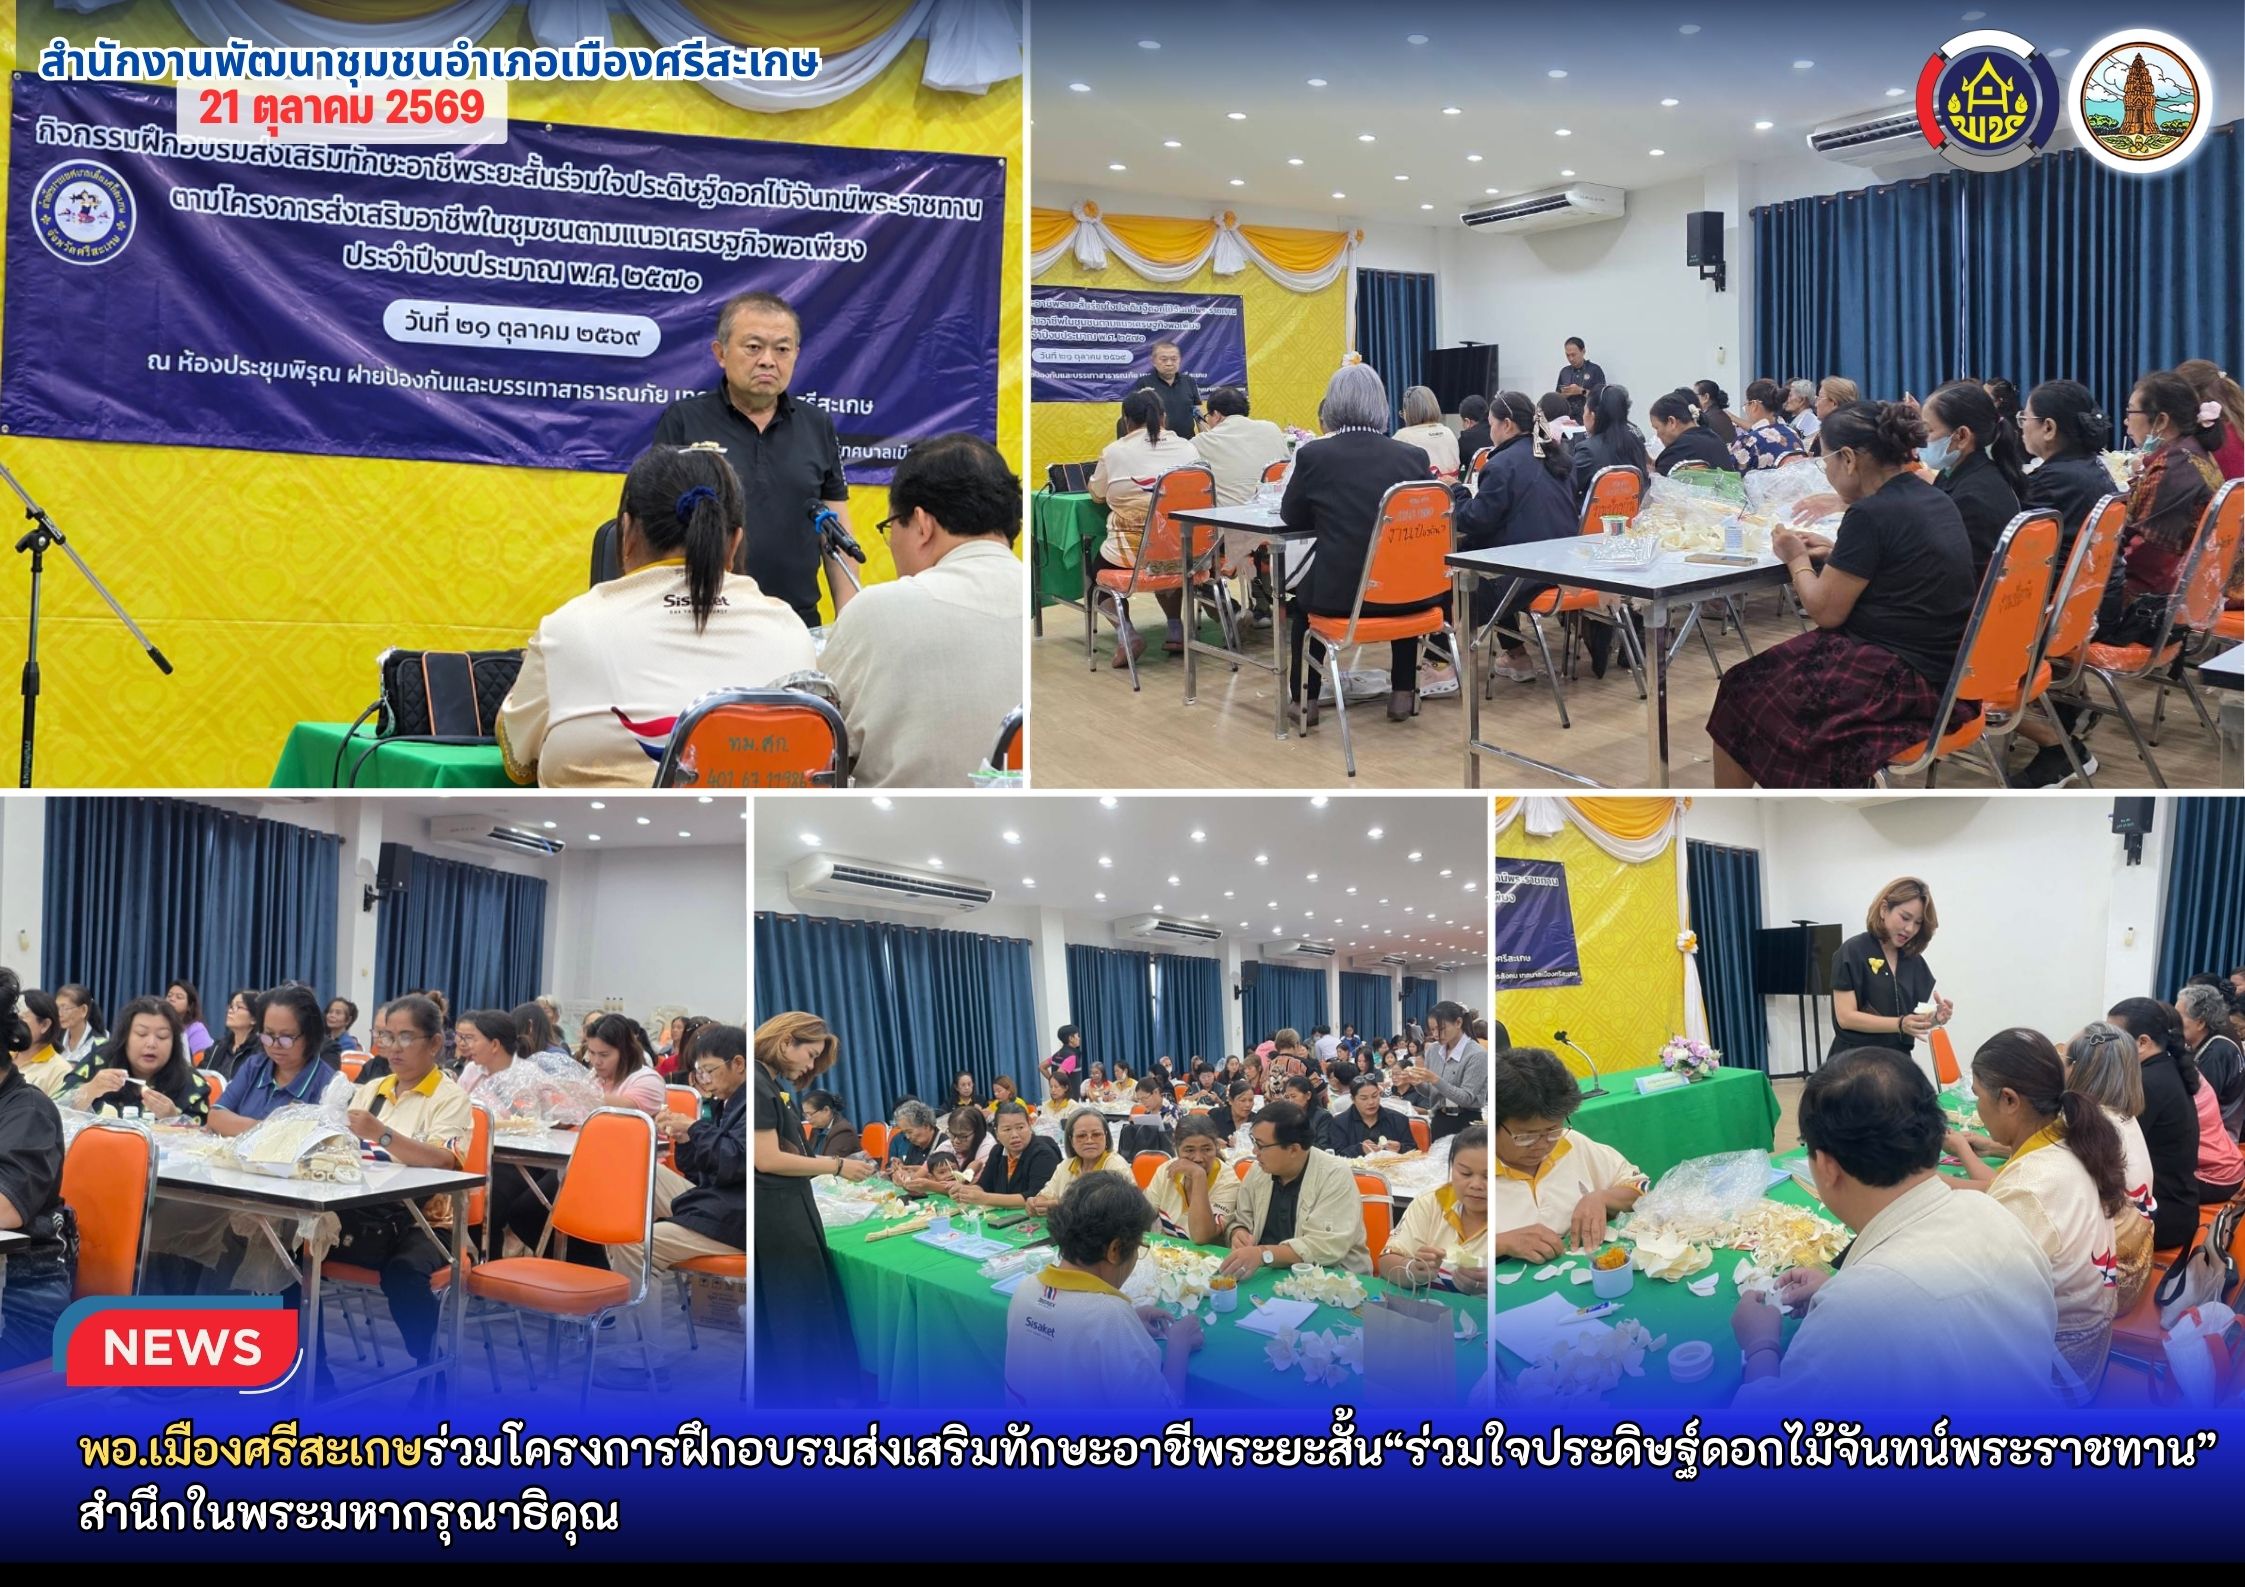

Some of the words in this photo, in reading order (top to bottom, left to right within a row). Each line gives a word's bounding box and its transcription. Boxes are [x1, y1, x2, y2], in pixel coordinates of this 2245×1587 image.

[170, 185, 867, 261] ตามโครงการส่งเสริมอาชีพในชุมชนตามแนวเศรษฐกิจพอเพียง
[343, 240, 563, 284] ประจำปีงบประมาณ
[569, 268, 618, 288] พ.ศ.
[624, 264, 703, 293] ๒๕๗๐
[405, 306, 450, 333] วันที่
[456, 317, 491, 339] ๒๑
[497, 321, 570, 345] ตุลาคม
[576, 325, 642, 347] ๒๕๖๙
[147, 353, 171, 371] ณ
[178, 350, 341, 388] ห้องประชุมพิรุณ
[347, 362, 669, 404] ฝ่ายป้องกันและบรรเทาสาธารณภัย
[663, 594, 730, 607] Siset
[1025, 1316, 1056, 1338] Sisaket
